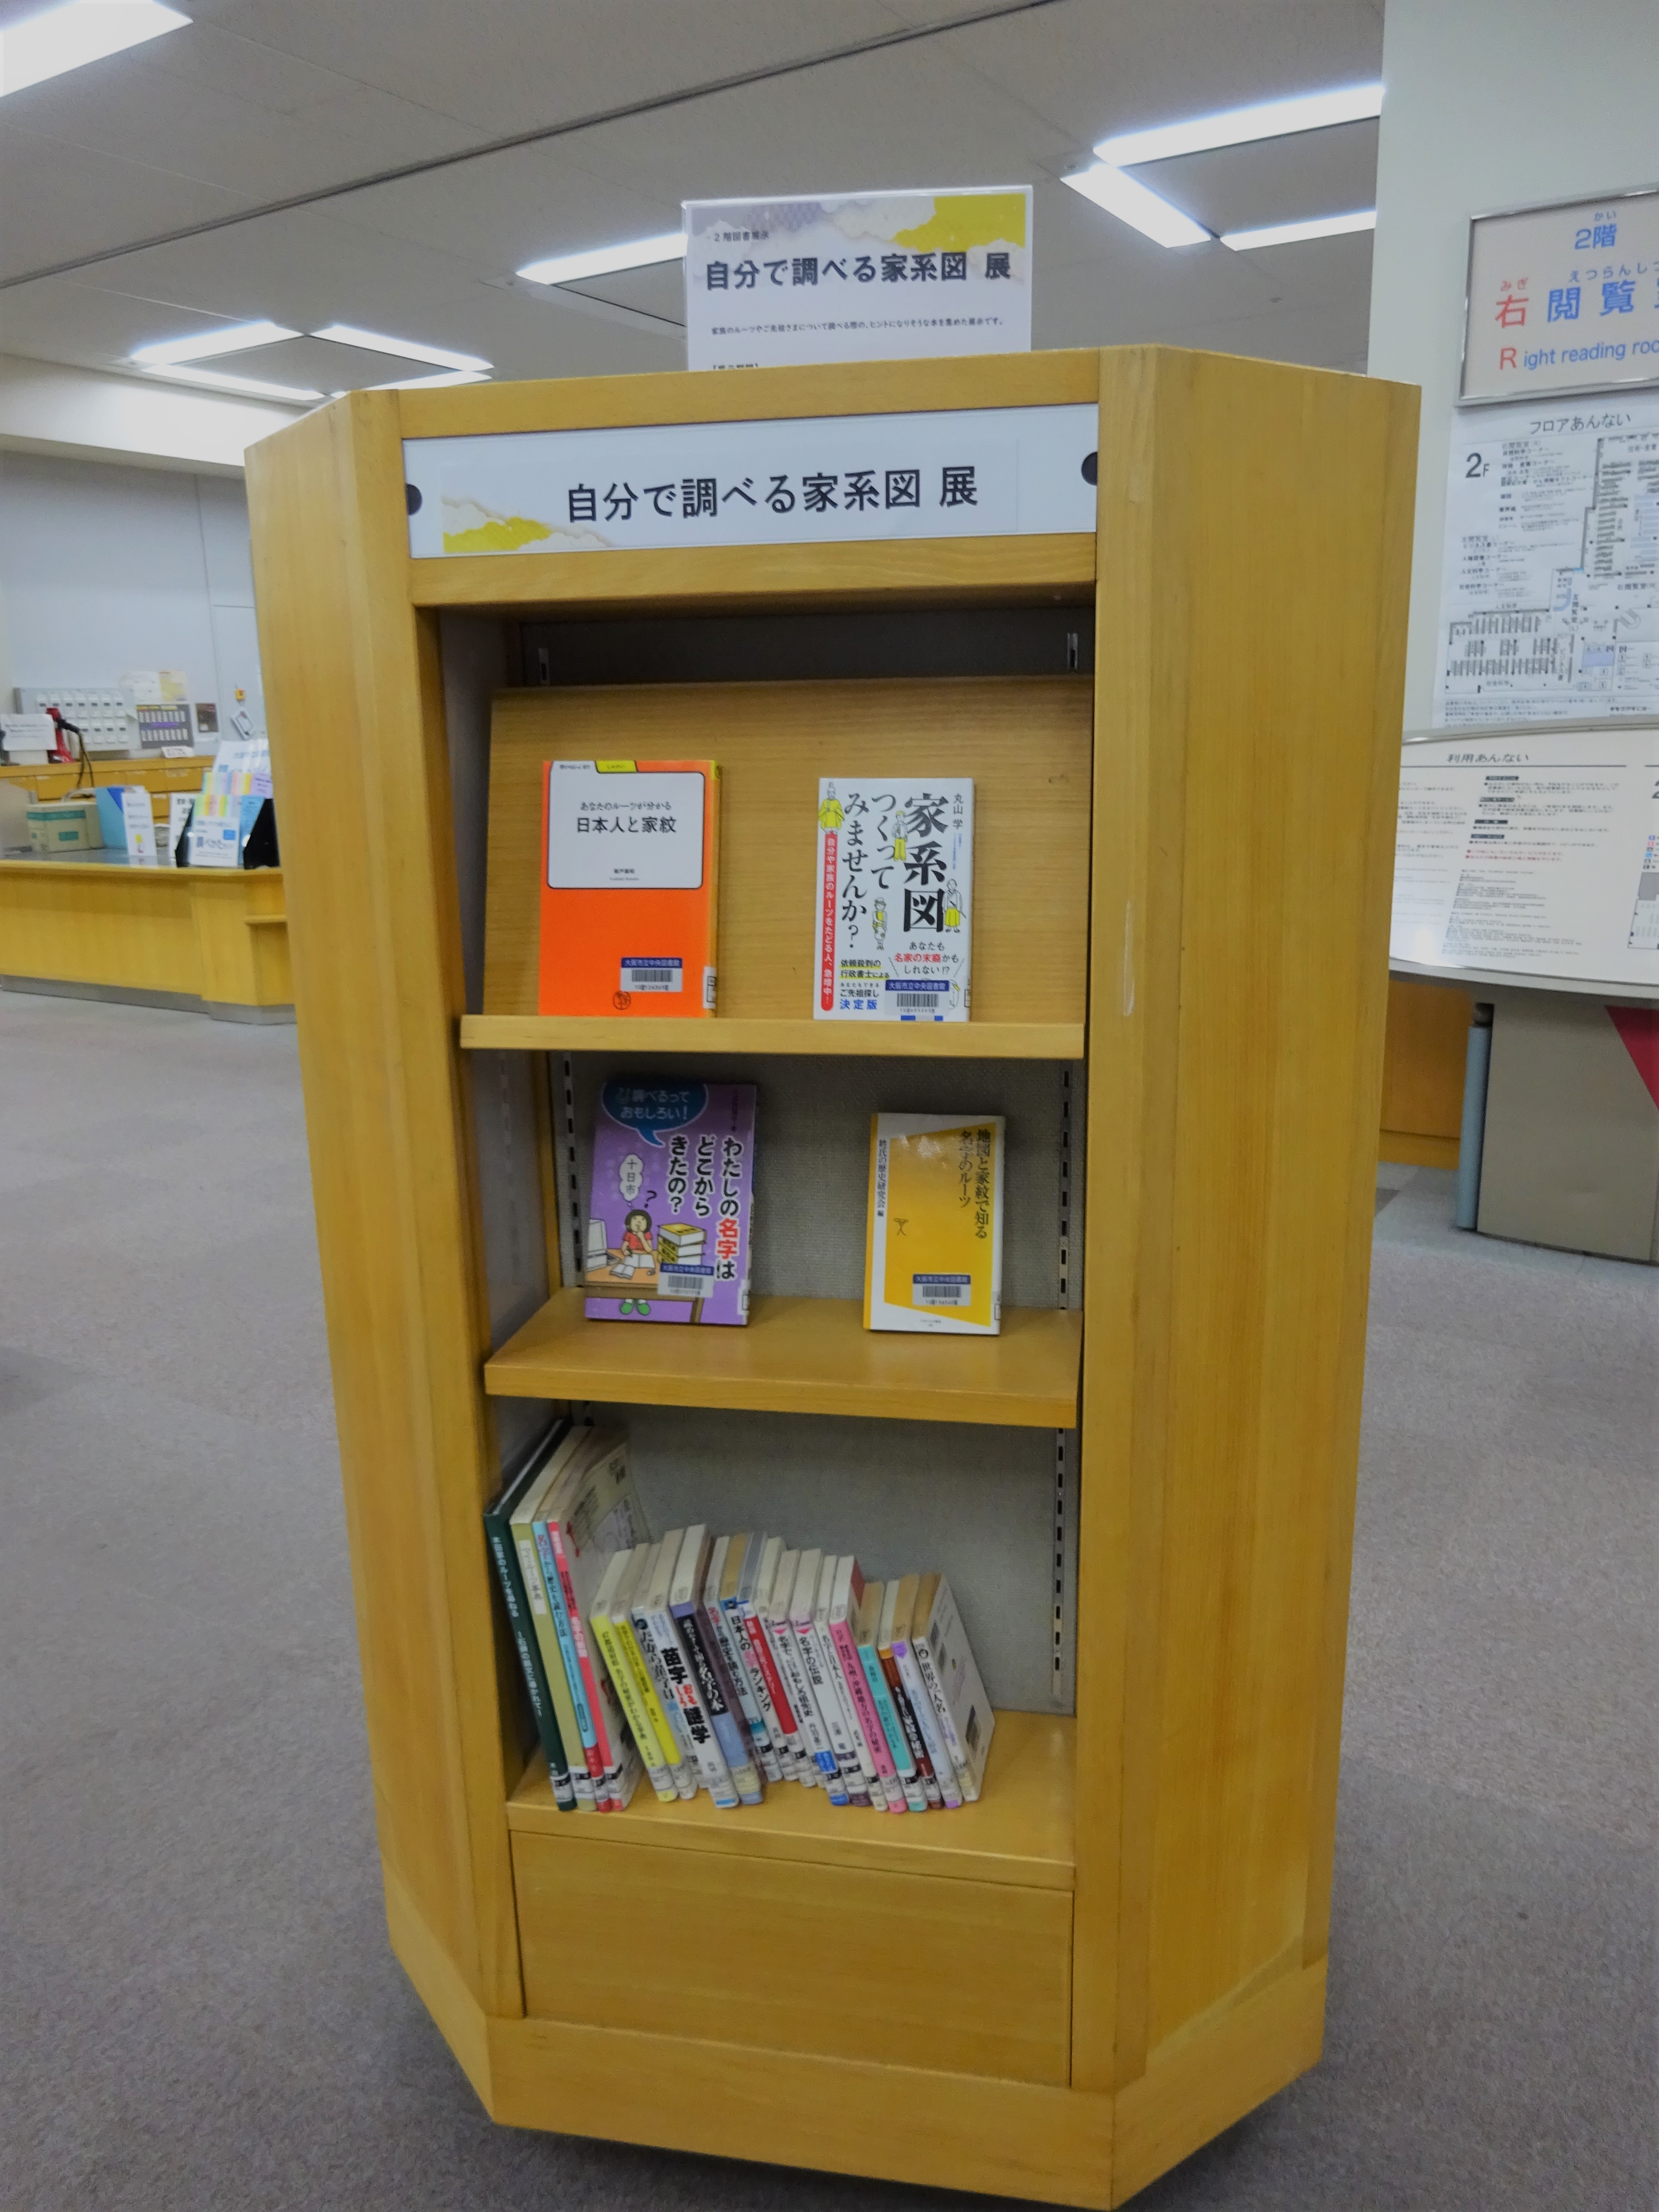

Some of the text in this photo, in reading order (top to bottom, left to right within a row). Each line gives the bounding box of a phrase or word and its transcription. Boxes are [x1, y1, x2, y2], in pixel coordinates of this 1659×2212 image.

[1575, 224, 1617, 250] 2階
[706, 252, 1011, 291] 自分で調べる家系図 展
[1500, 277, 1528, 292] みぎ
[1495, 277, 1659, 329] 右 閲覧
[1561, 342, 1626, 363] reading
[1530, 412, 1631, 435] フロアあんない
[1465, 452, 1490, 479] 2F
[567, 465, 979, 522] 自分で調べる家系図 展
[1447, 753, 1529, 763] 利用あんない
[580, 801, 672, 811] あなたのルーツが分かる
[577, 816, 677, 834] 日本人と家紋
[871, 794, 896, 890] つくって
[904, 792, 949, 933] 家系図
[909, 941, 946, 951] あなたも
[839, 998, 878, 1010] 決定版
[694, 1135, 715, 1218] どこから
[716, 1137, 743, 1280] わたしの名字は
